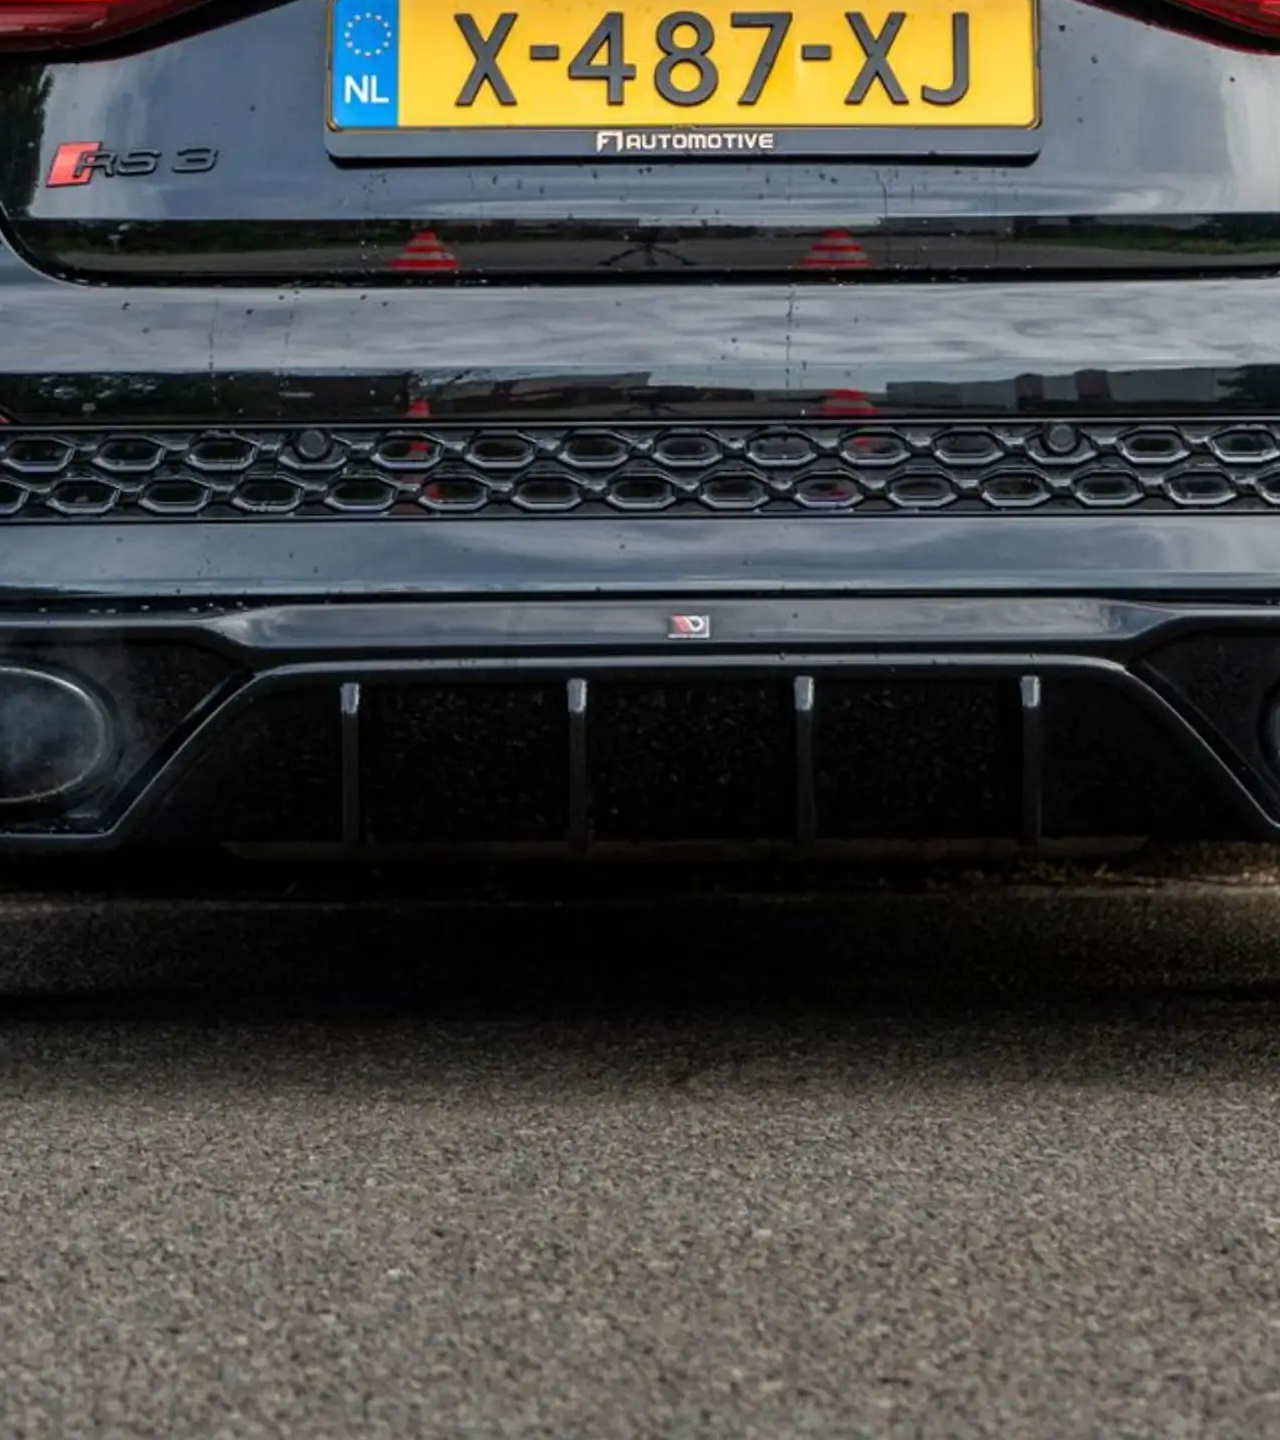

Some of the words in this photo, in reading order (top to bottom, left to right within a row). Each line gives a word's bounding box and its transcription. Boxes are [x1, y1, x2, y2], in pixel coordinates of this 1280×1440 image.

[454, 10, 971, 108] X-487-XJ
[344, 74, 389, 104] NL
[171, 147, 220, 174] 3
